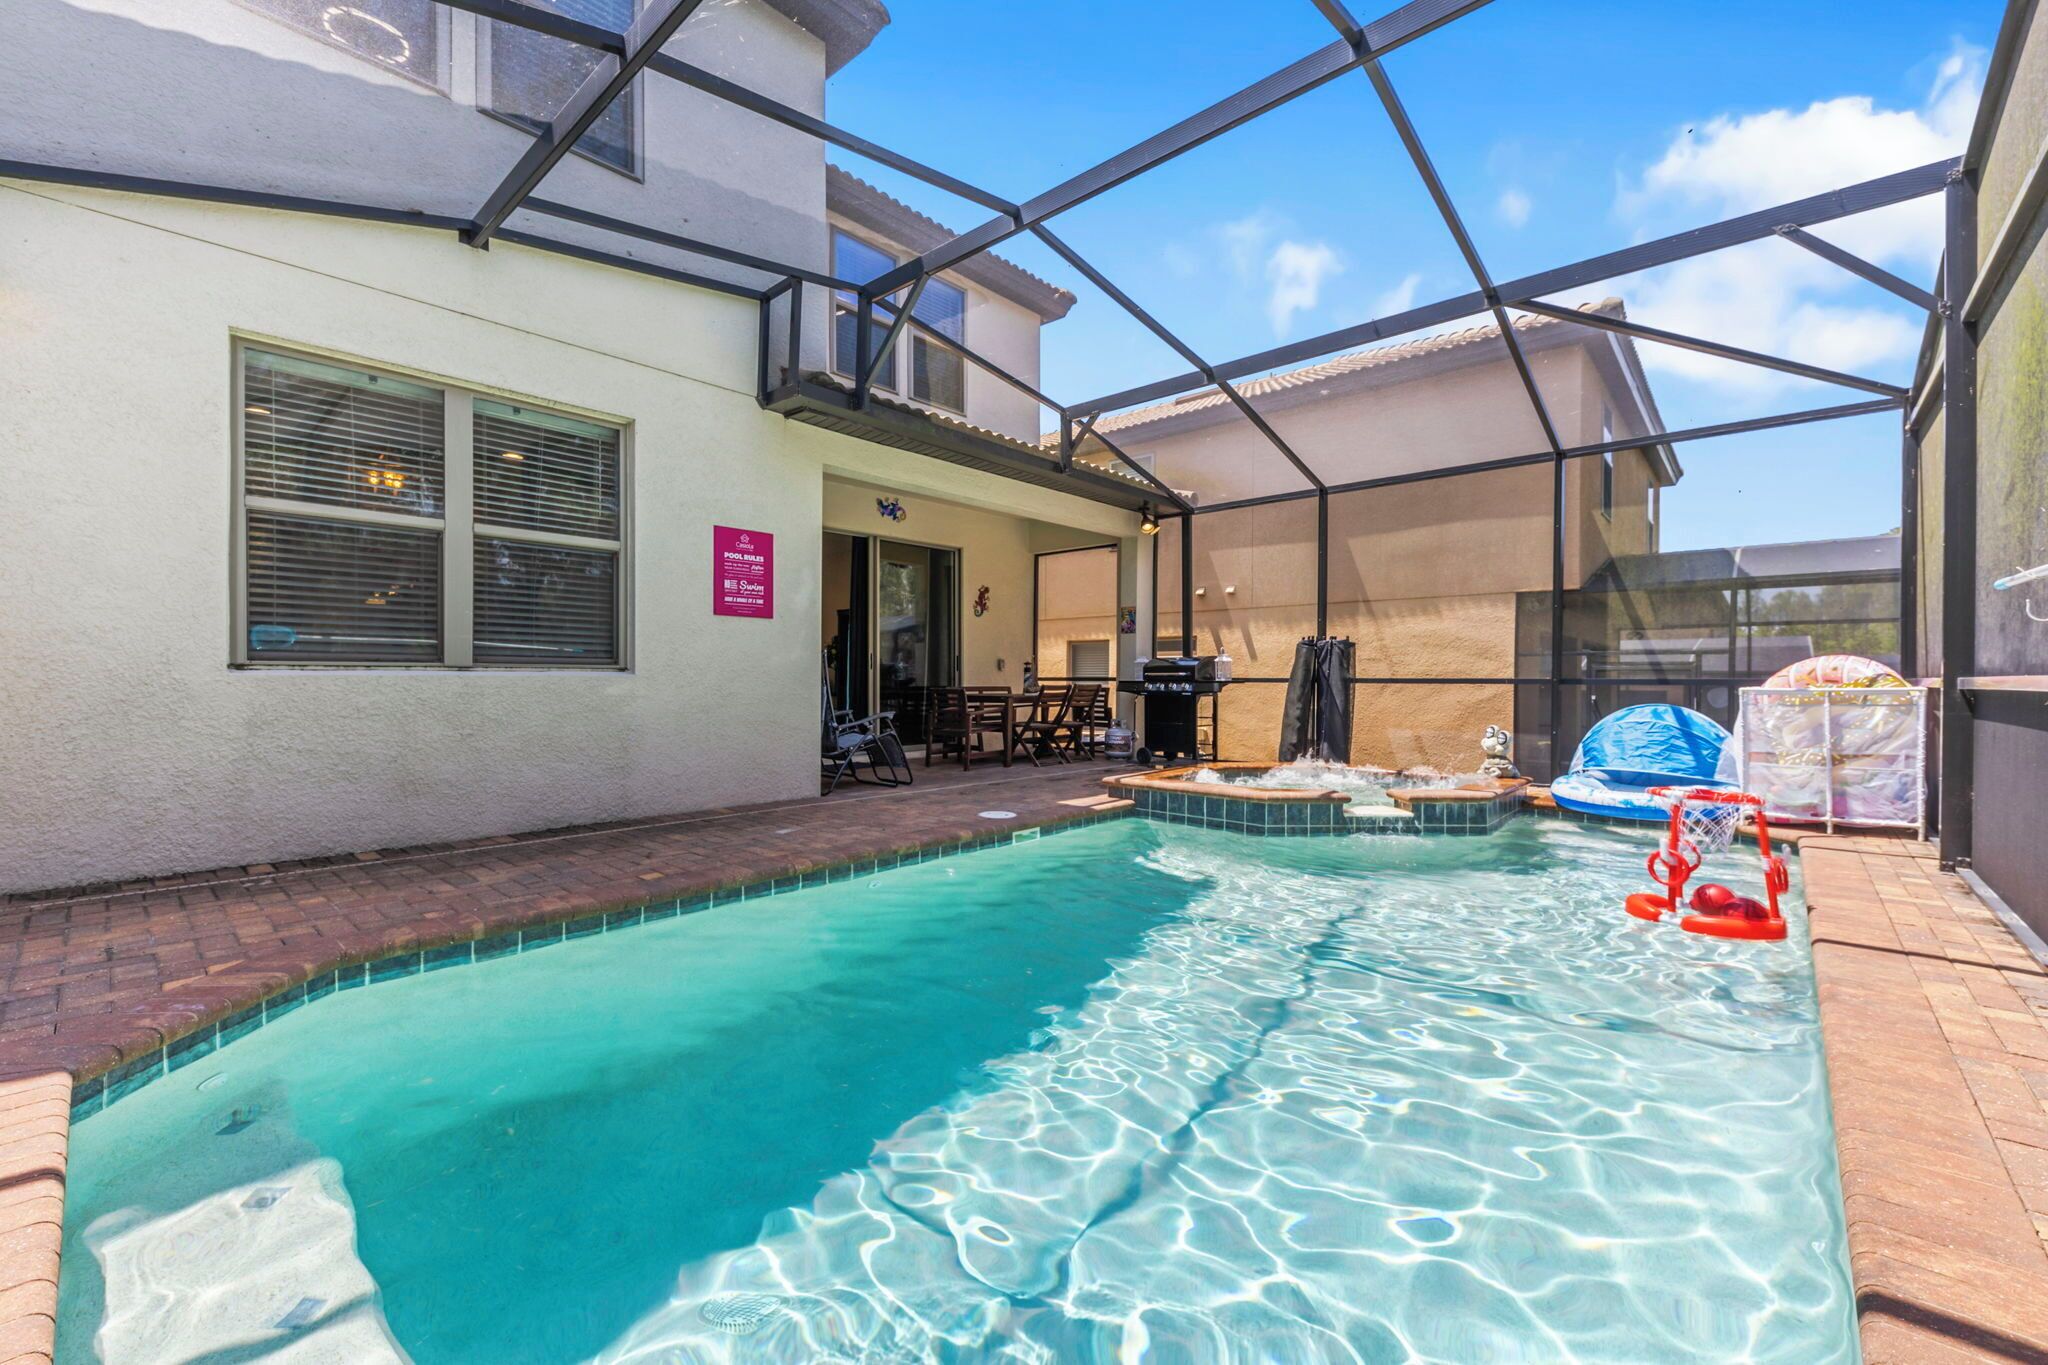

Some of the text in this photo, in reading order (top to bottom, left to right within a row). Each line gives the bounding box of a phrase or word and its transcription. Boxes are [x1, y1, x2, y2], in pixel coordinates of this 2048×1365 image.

[724, 552, 764, 562] POOL RULES
[739, 580, 764, 591] Swim
